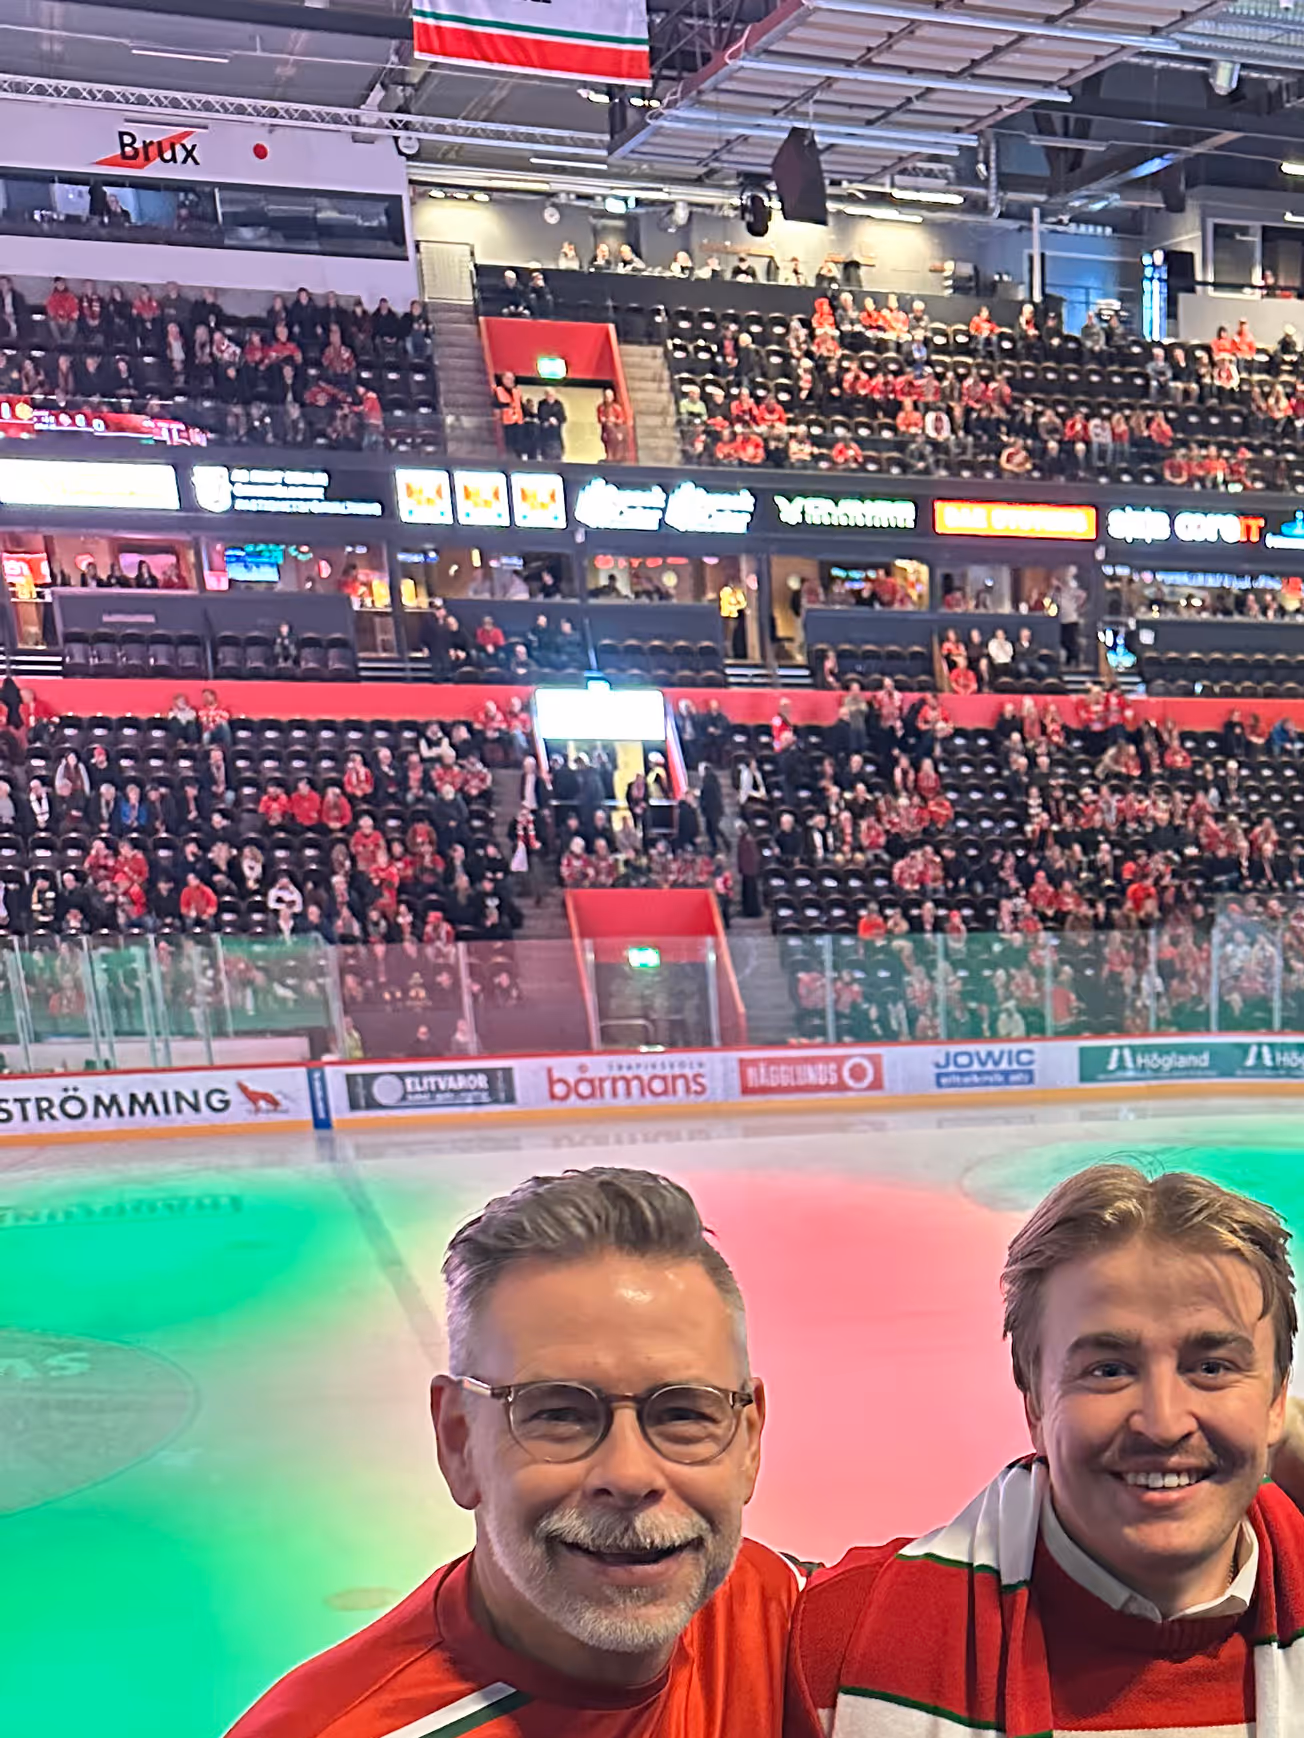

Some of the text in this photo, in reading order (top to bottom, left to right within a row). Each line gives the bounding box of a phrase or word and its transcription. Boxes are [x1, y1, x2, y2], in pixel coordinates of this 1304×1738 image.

[118, 130, 200, 167] Brux
[934, 1048, 1036, 1070] JOWIC
[1136, 1051, 1210, 1072] Högland
[745, 1061, 838, 1088] HÄGGLUNDS
